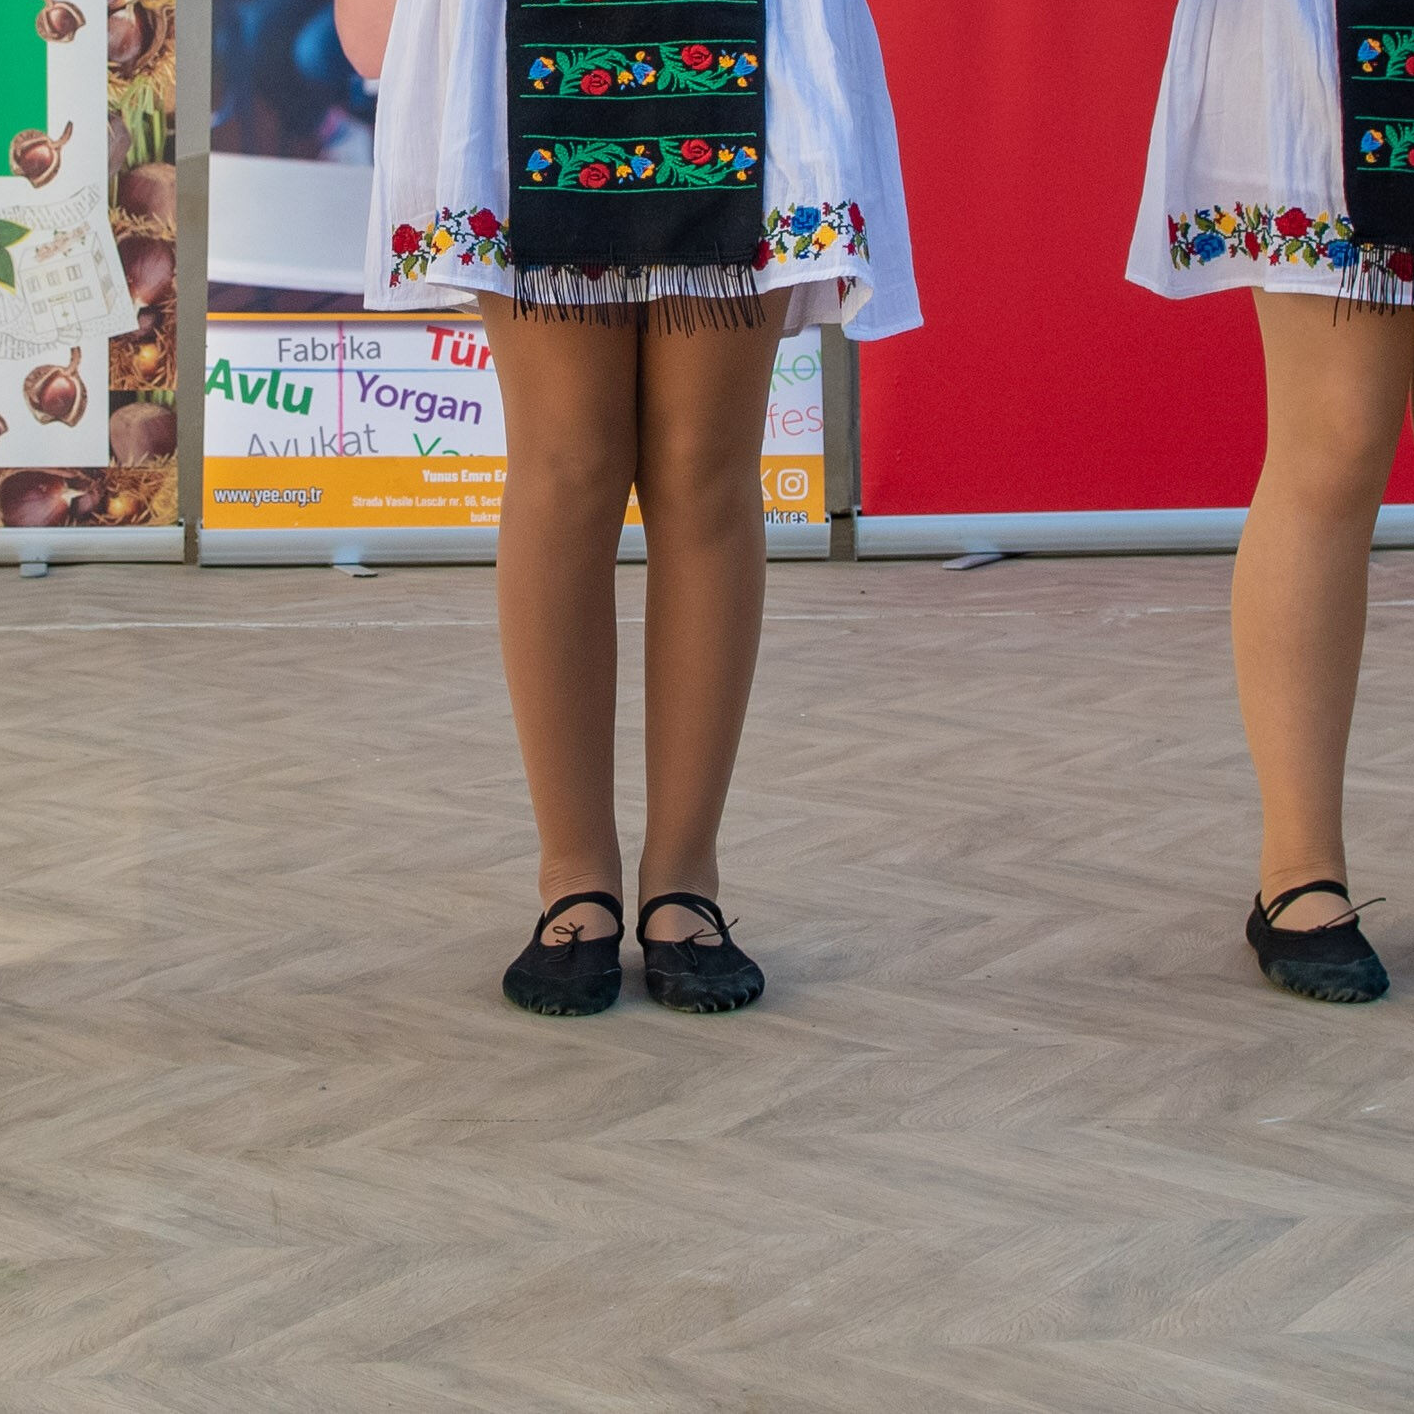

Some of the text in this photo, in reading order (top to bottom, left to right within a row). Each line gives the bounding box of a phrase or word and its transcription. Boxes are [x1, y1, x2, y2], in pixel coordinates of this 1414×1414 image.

[278, 336, 382, 363] Fabrika
[205, 358, 314, 415] Avlu
[356, 370, 482, 425] Yorgan
[213, 487, 323, 507] www.yee.org.tr
